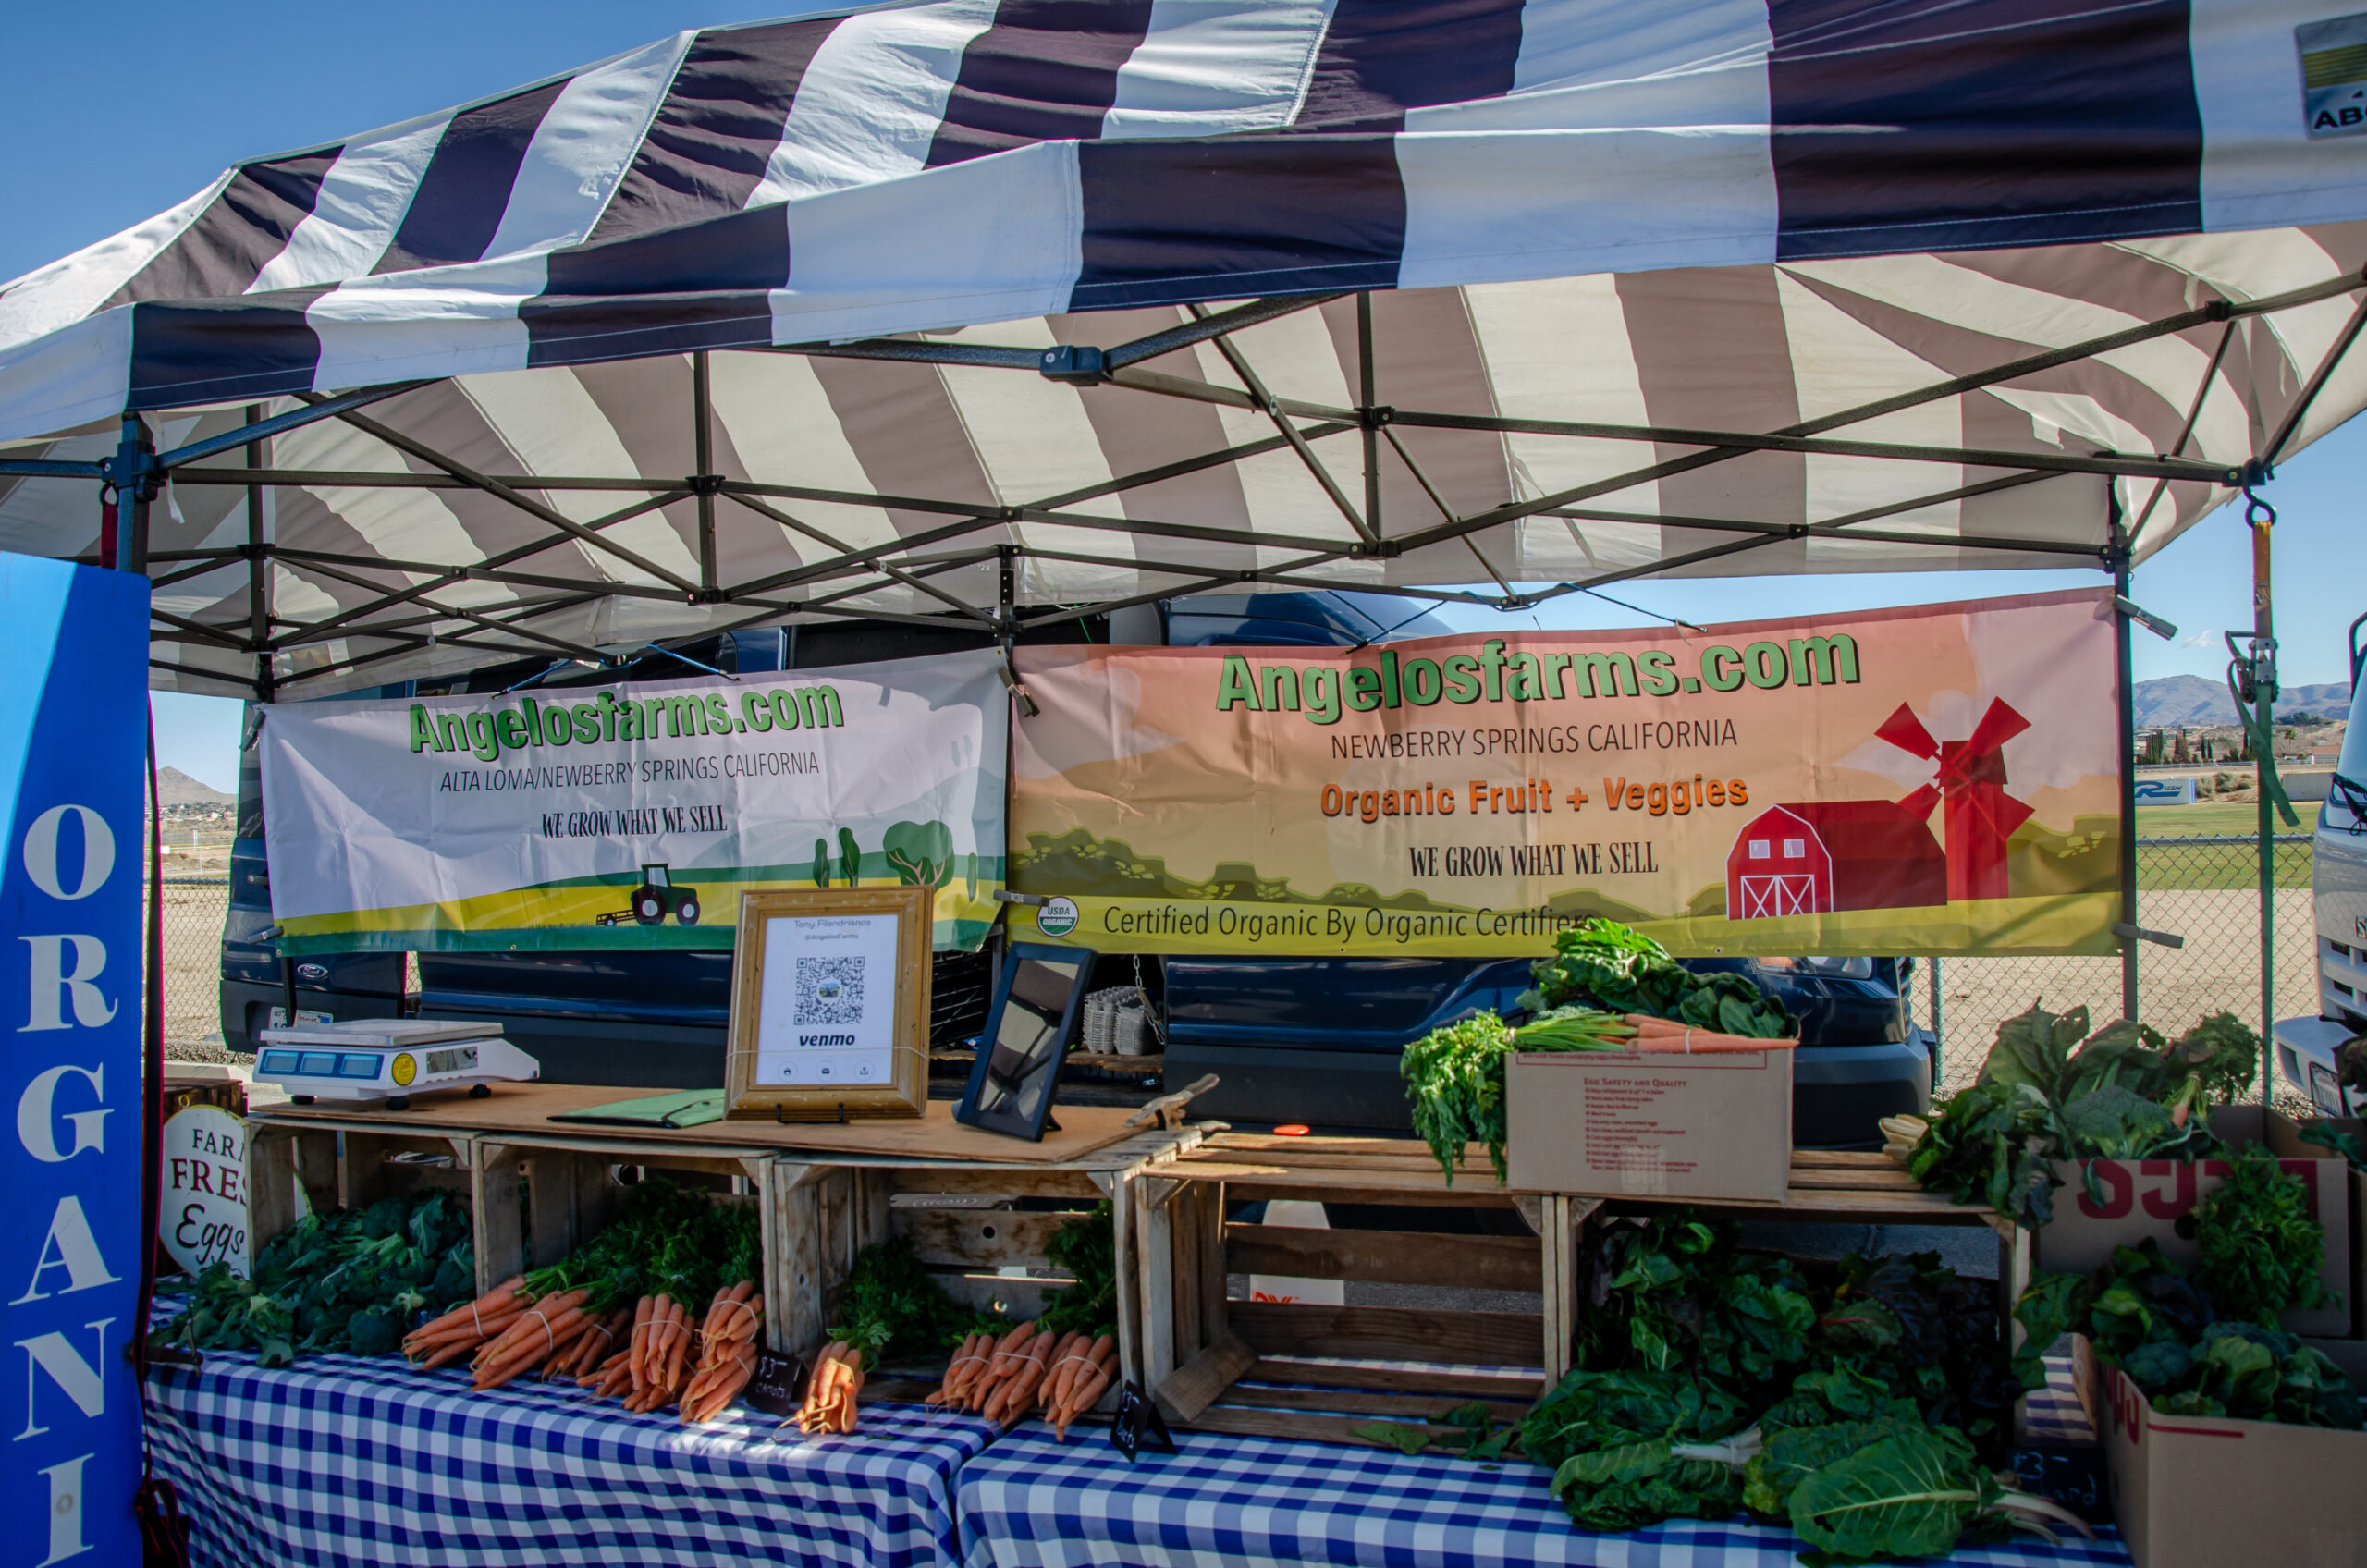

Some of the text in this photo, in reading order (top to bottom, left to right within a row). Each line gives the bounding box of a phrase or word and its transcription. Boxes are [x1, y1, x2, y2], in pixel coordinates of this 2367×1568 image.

[2313, 106, 2367, 130] AB
[1216, 631, 1860, 725] Angelosfarms.com
[410, 684, 844, 762] Angelosfarms.com
[1331, 718, 1738, 760] NEWBERRY SPRINGS CALIFORNIA
[440, 751, 820, 792] ALTA LOMA/NEWBERRY SPRINGS CALIFORNIA
[1320, 781, 1455, 823] Organic
[1468, 778, 1553, 815] Fruit
[1602, 773, 1748, 817] Veggies
[542, 804, 728, 839] WE GROW WHAT WE SELL
[1409, 840, 1659, 878] WE GROW WHAT WE SELL
[794, 918, 872, 929] Tony Filandrianos
[1042, 918, 1073, 926] ORGANIC
[1048, 906, 1070, 915] USDA
[1104, 905, 1595, 943] Certified Organic By Organic Certifier
[798, 1034, 855, 1047] venmo
[192, 1128, 244, 1162] FAR
[176, 1203, 245, 1266] Eggs
